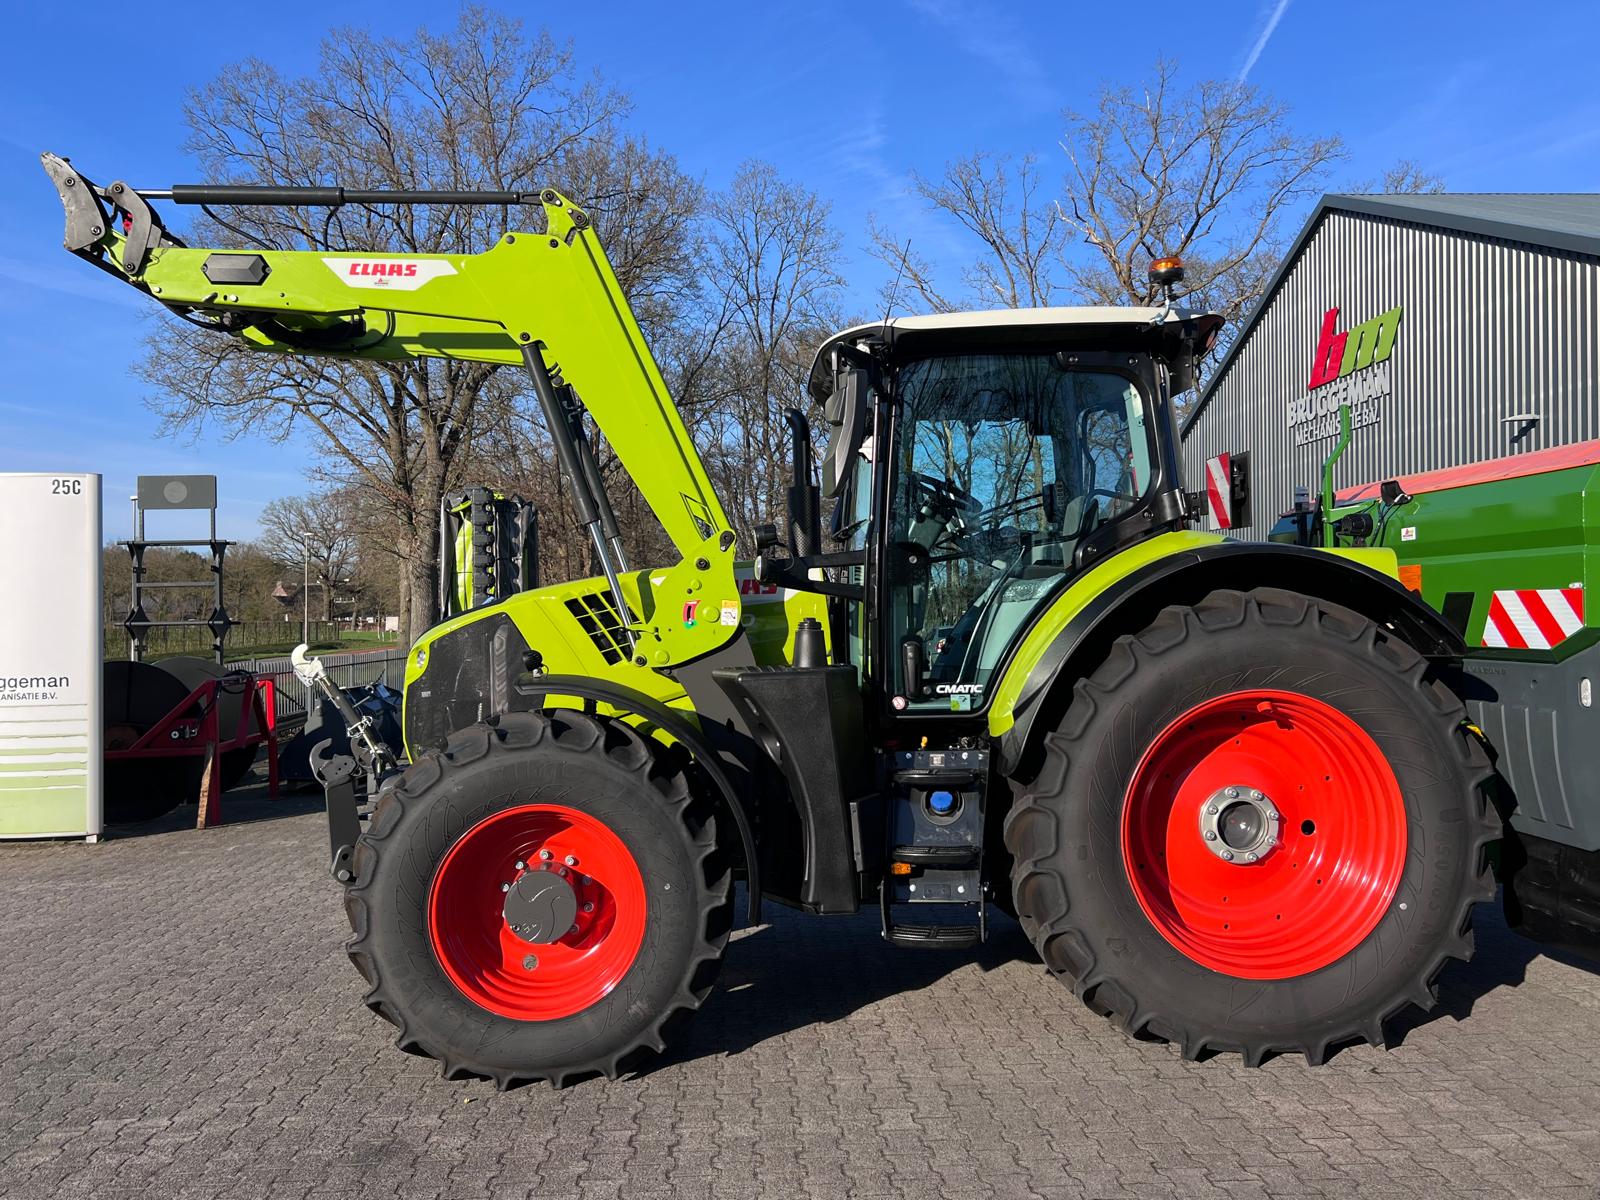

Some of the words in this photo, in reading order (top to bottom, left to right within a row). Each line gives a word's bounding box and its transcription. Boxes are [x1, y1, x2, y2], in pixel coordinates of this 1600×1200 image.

[349, 263, 418, 277] CLAAS
[1288, 360, 1391, 428] BRUGGEMAN
[1296, 411, 1362, 447] MECHANISIE
[52, 479, 81, 495] 25C
[41, 691, 58, 700] B.V.
[936, 684, 984, 694] CMATIC
